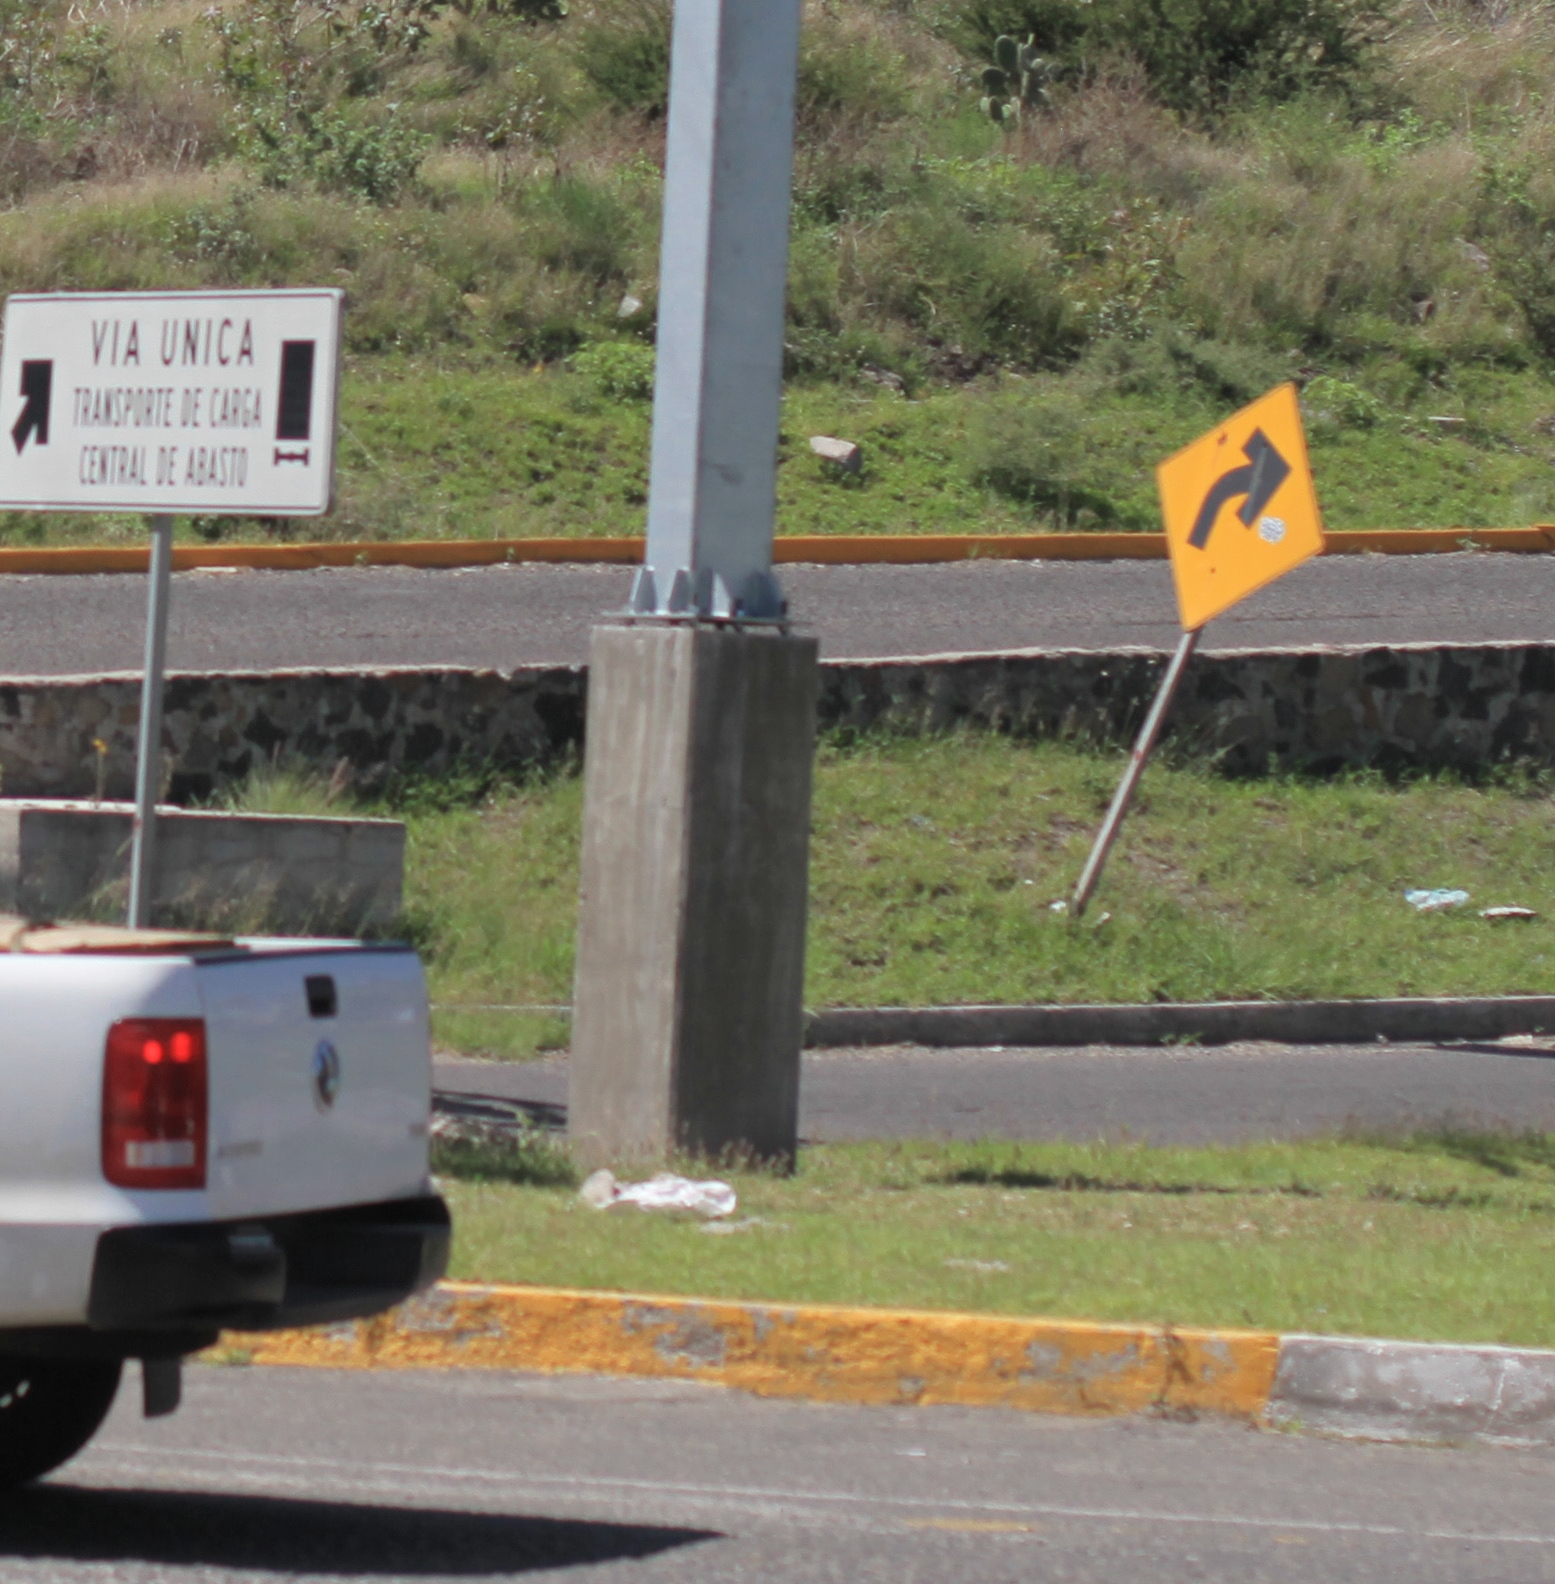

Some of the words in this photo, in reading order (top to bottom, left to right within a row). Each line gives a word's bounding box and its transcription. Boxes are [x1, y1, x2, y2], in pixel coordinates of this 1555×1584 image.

[92, 319, 140, 366] VIA
[161, 318, 254, 366] UNICA
[73, 387, 175, 428] TRANSPORTE
[181, 387, 203, 428] DE
[209, 387, 262, 428] CARGA
[79, 445, 148, 486] CENTRAL
[156, 445, 179, 486] DE
[185, 446, 249, 487] ABASTO
